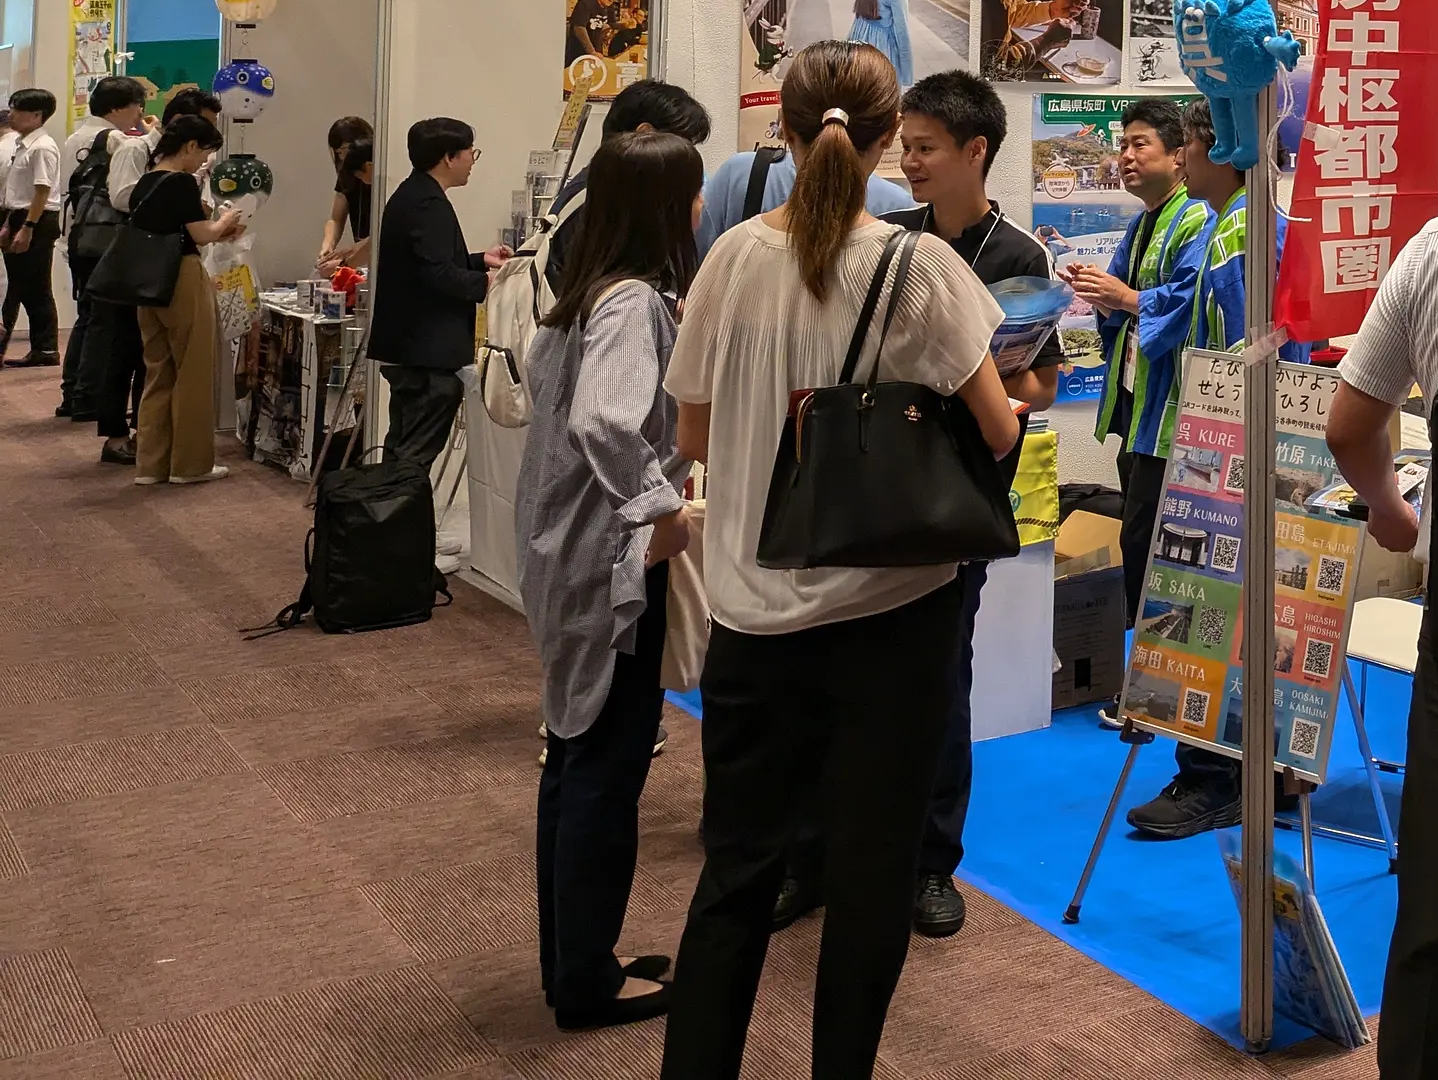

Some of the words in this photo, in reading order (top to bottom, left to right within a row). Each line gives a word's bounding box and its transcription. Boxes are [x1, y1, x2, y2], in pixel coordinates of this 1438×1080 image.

[744, 95, 759, 104] Your
[761, 94, 779, 103] travel
[1047, 99, 1105, 113] 広島県坂町
[1198, 428, 1236, 448] KURE
[1276, 441, 1306, 465] 竹原
[1310, 455, 1337, 469] TAKE
[1162, 496, 1192, 520] 熊野
[1193, 508, 1238, 527] KUMANO
[1275, 519, 1306, 545] 田島
[1148, 571, 1163, 592] 坂
[1169, 580, 1206, 602] SAKA
[1304, 612, 1337, 628] HIGASHI
[1303, 623, 1341, 640] HIROSHIM
[1133, 645, 1162, 670] 海田
[1166, 659, 1205, 682] KAITA
[1291, 689, 1324, 706] OOSAKI
[1289, 703, 1329, 720] KAMIJIM
